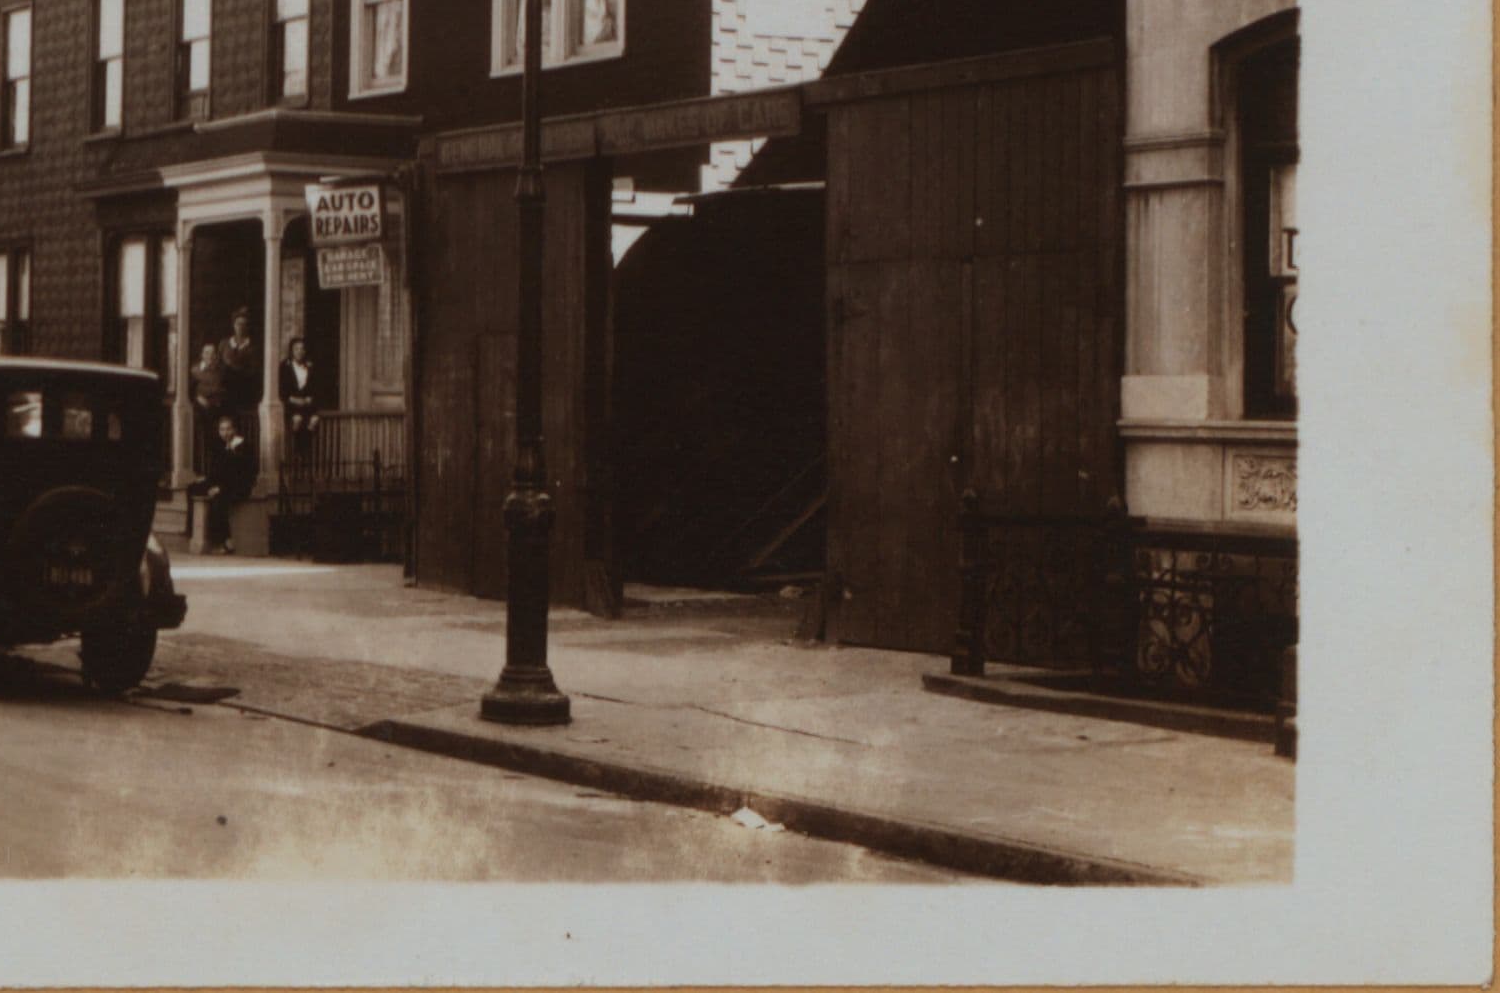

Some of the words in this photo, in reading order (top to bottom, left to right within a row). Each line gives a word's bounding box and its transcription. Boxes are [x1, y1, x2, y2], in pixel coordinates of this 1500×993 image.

[738, 96, 791, 129] CARS
[316, 191, 374, 213] AUTO
[316, 213, 379, 238] REPAIRS
